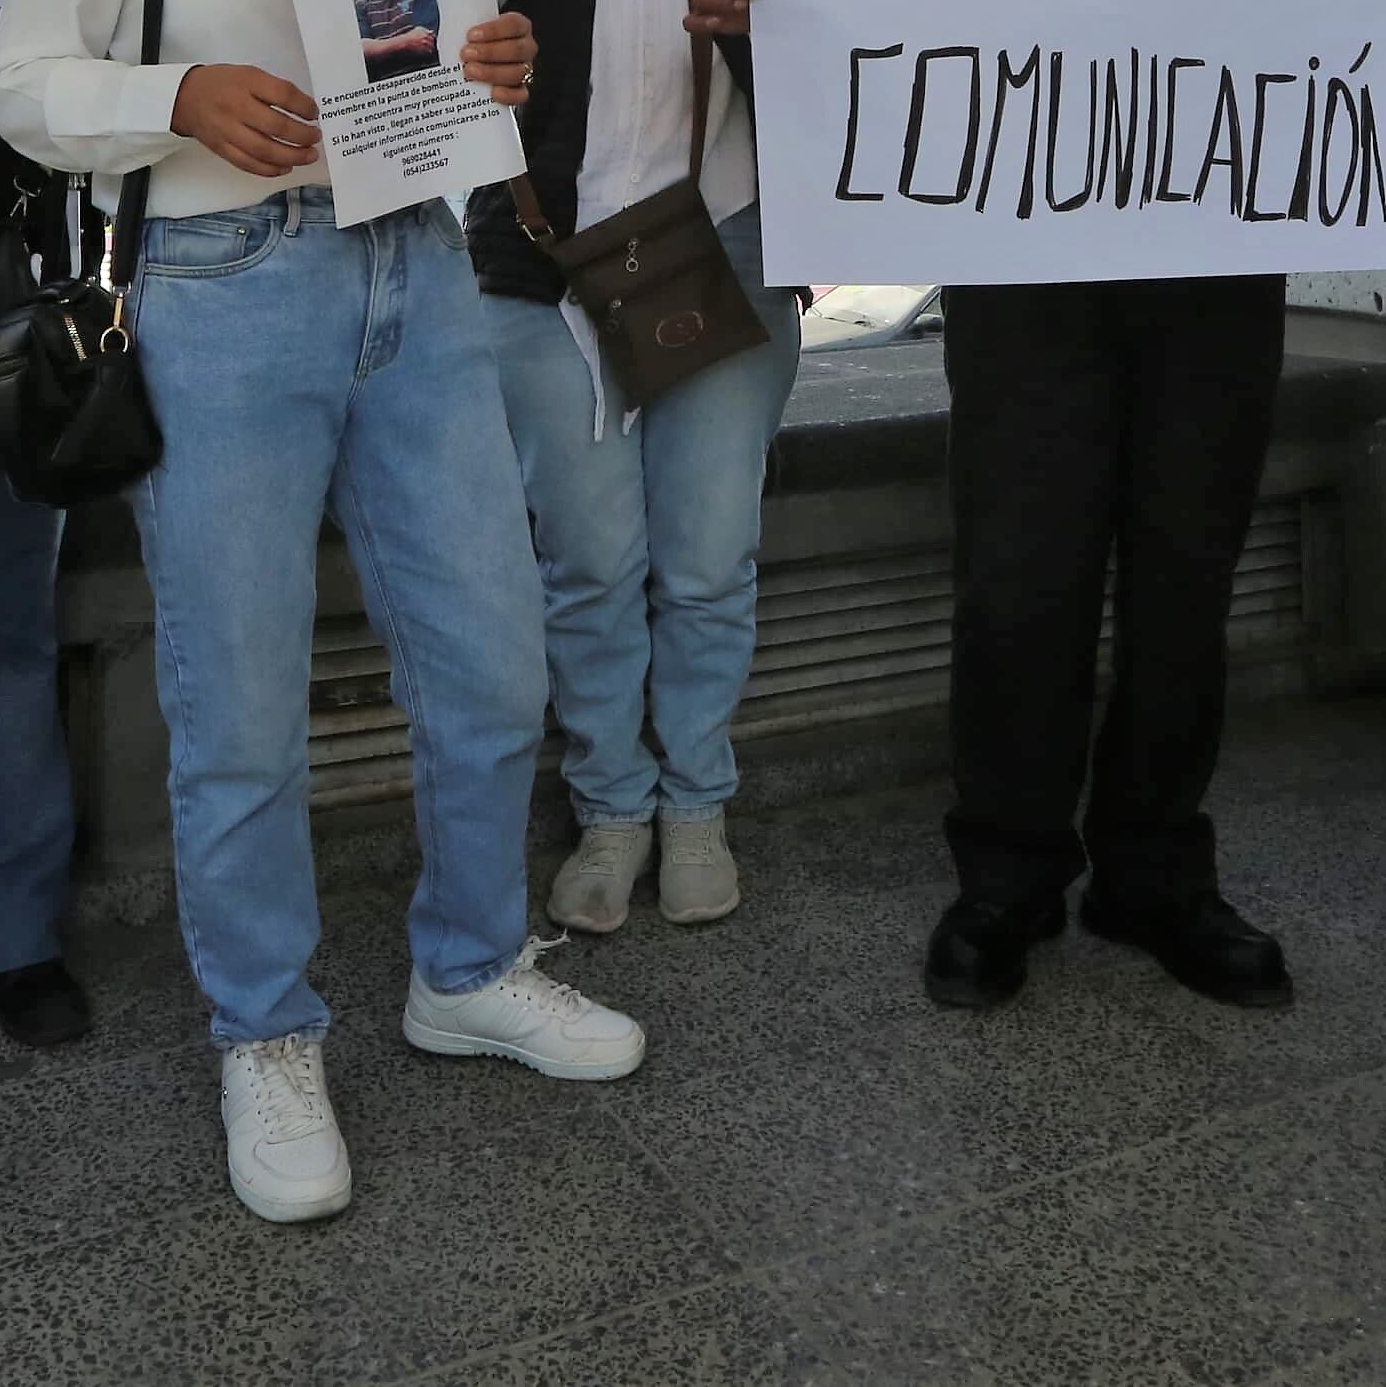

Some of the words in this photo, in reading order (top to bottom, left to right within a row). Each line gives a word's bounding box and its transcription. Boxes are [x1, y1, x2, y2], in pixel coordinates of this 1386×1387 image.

[321, 97, 333, 106] Se
[334, 86, 375, 103] encuentra
[376, 72, 427, 92] desaparecido
[427, 66, 451, 78] desde
[453, 62, 461, 72] el
[321, 103, 366, 120] noviembre
[367, 99, 377, 108] en
[377, 96, 386, 105] la
[387, 91, 409, 105] punta
[410, 87, 421, 96] de
[354, 117, 363, 126] se
[364, 106, 403, 123] encuentra
[404, 101, 421, 111] muy
[422, 88, 471, 109] preocupada
[341, 134, 350, 143] lo
[350, 130, 366, 141] han
[367, 125, 385, 135] visto
[390, 117, 414, 128] llegan
[421, 108, 443, 120] saber
[445, 106, 455, 114] su
[342, 140, 377, 157] cualquier
[425, 114, 480, 132] comunicarse
[487, 109, 500, 118] los
[383, 142, 417, 159] siguiente
[403, 158, 449, 179] (054)233567
